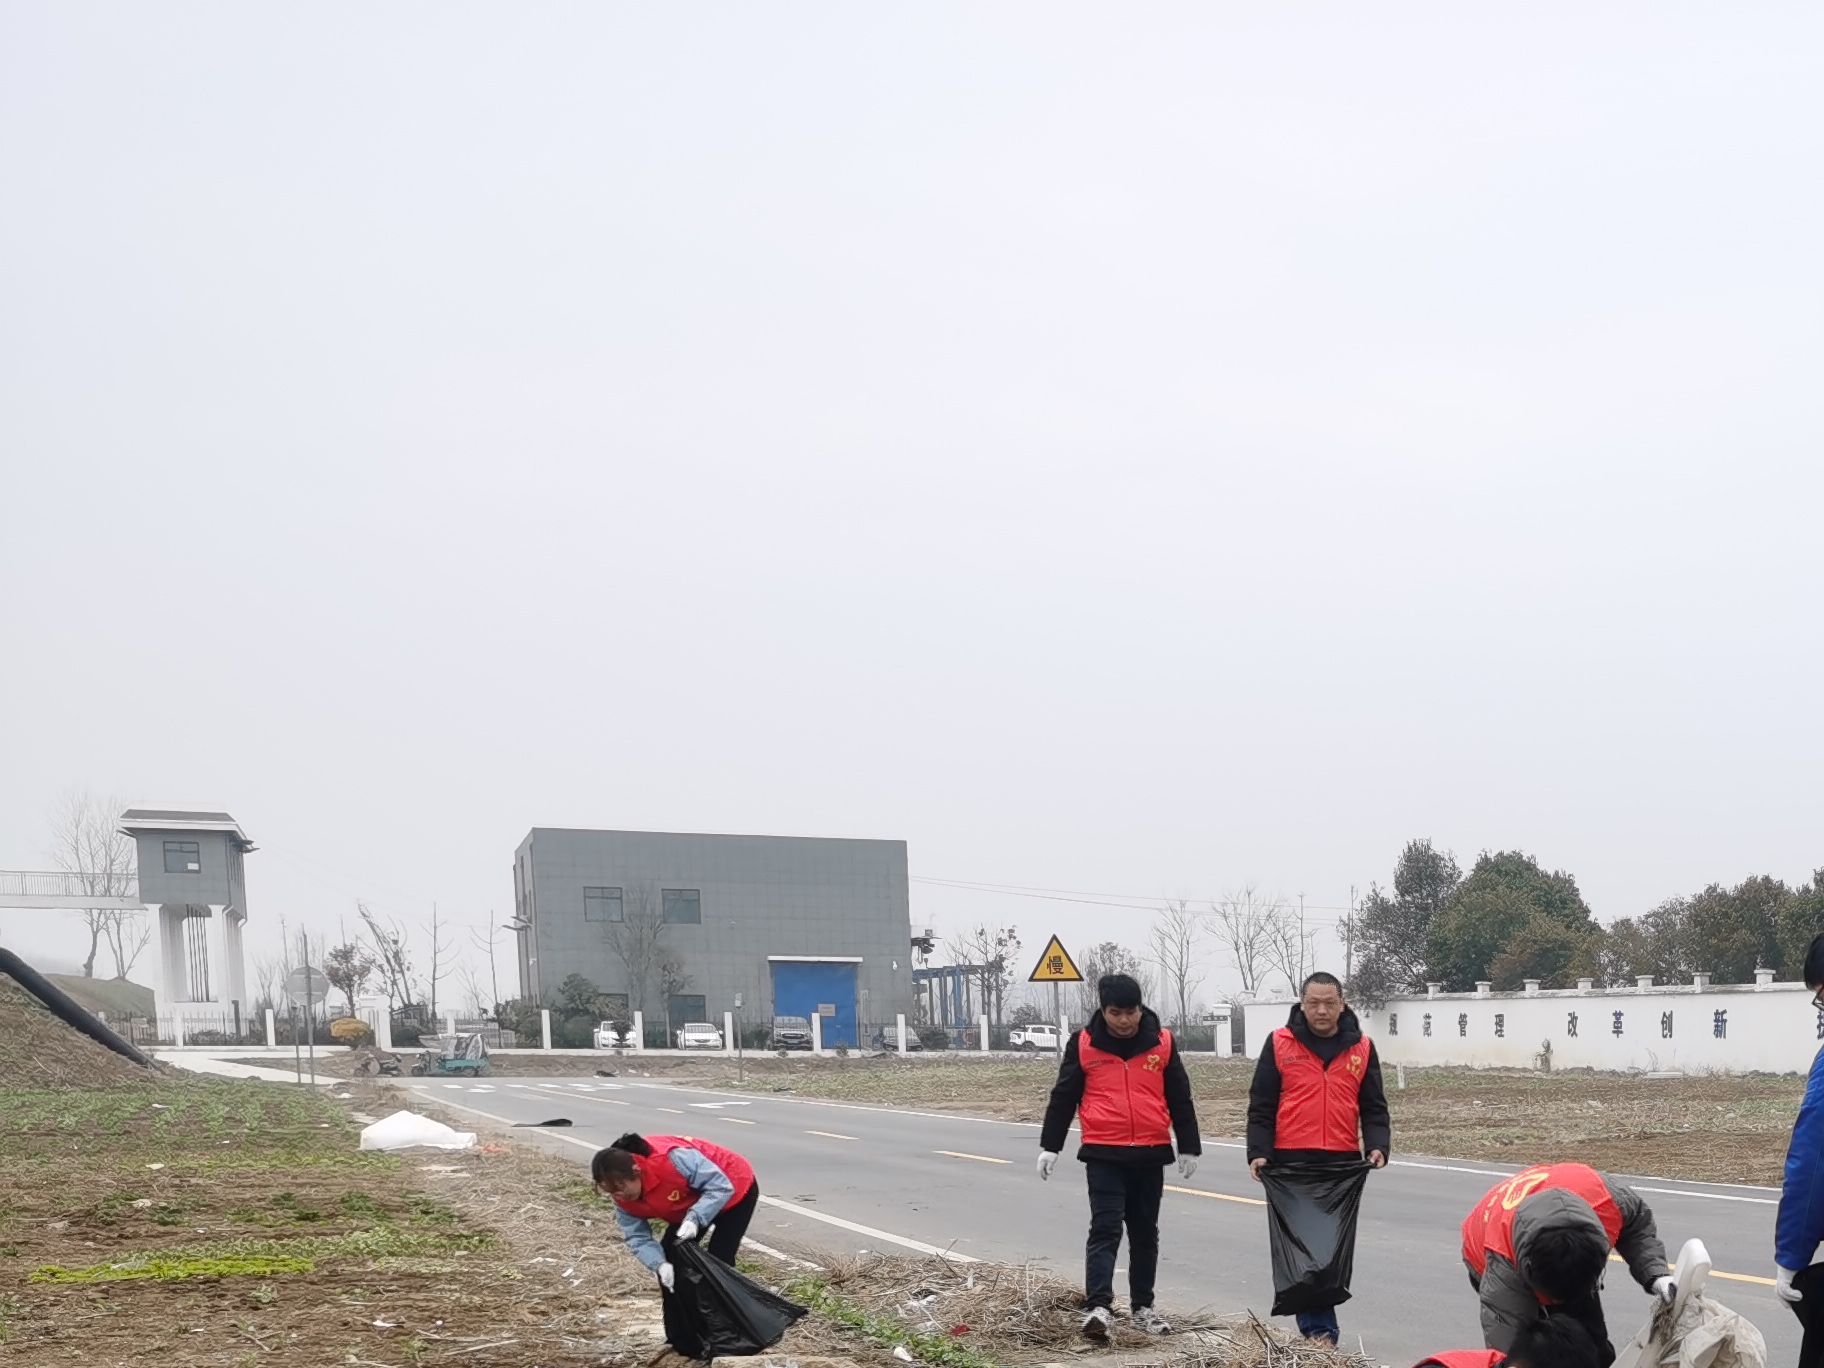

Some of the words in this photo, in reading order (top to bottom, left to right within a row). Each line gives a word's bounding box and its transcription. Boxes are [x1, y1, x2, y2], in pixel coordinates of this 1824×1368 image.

[1047, 955, 1064, 975] 慢
[1567, 1009, 1728, 1039] 改革创新
